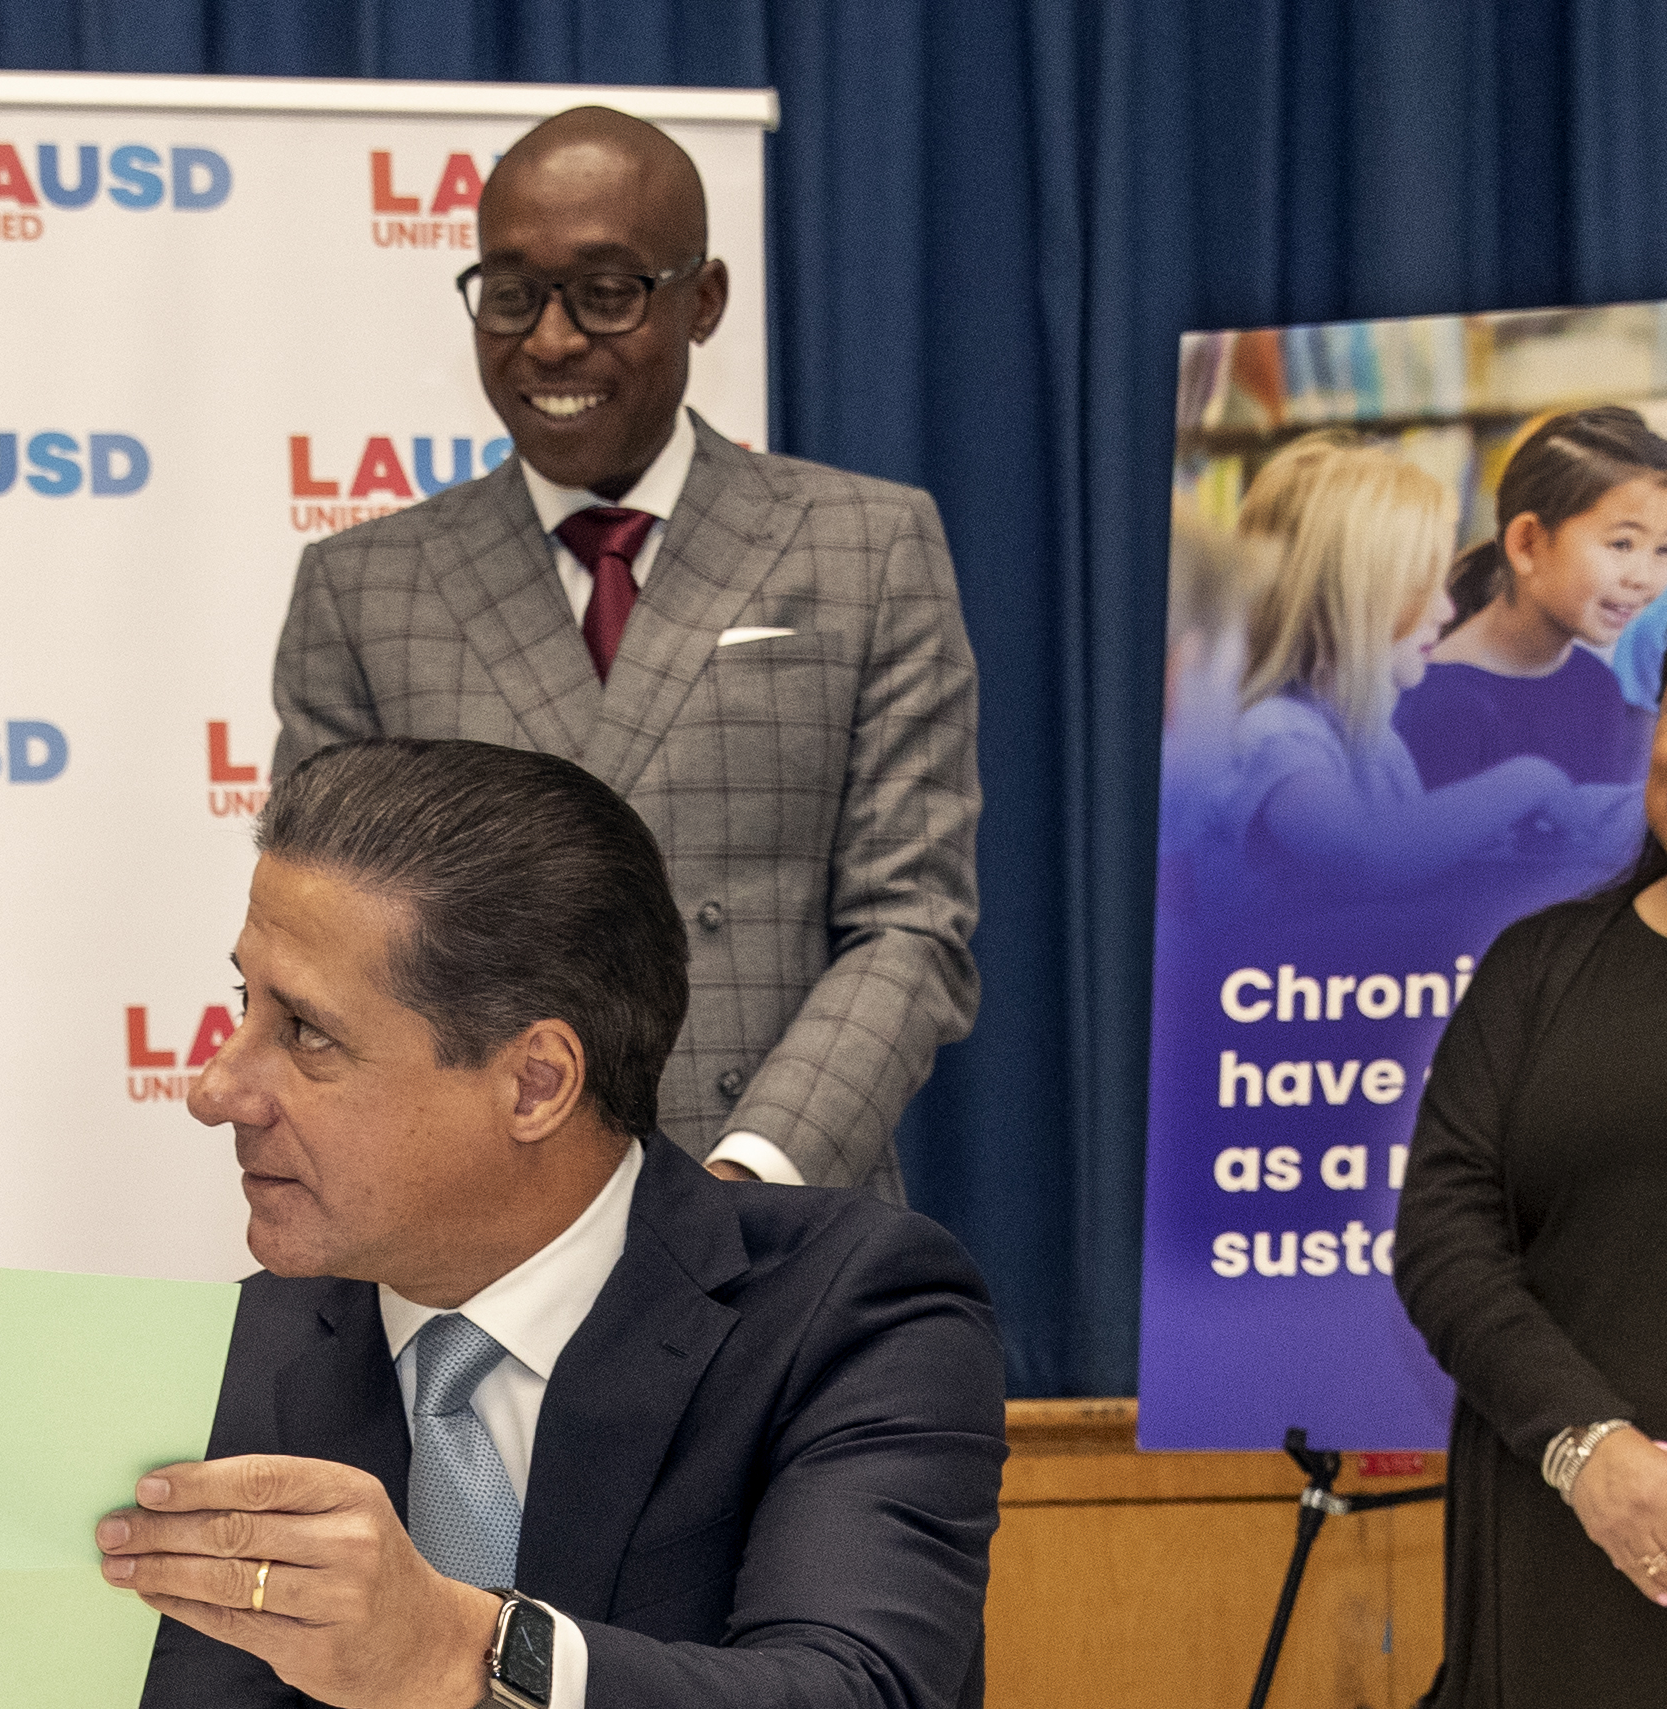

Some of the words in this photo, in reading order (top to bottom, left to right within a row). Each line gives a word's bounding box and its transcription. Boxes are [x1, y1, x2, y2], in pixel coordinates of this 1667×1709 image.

[371, 151, 504, 213] LA
[1220, 954, 1475, 1023] Chroni
[1218, 1051, 1406, 1107] have
[1213, 1146, 1303, 1192] as
[1320, 1144, 1368, 1190] a
